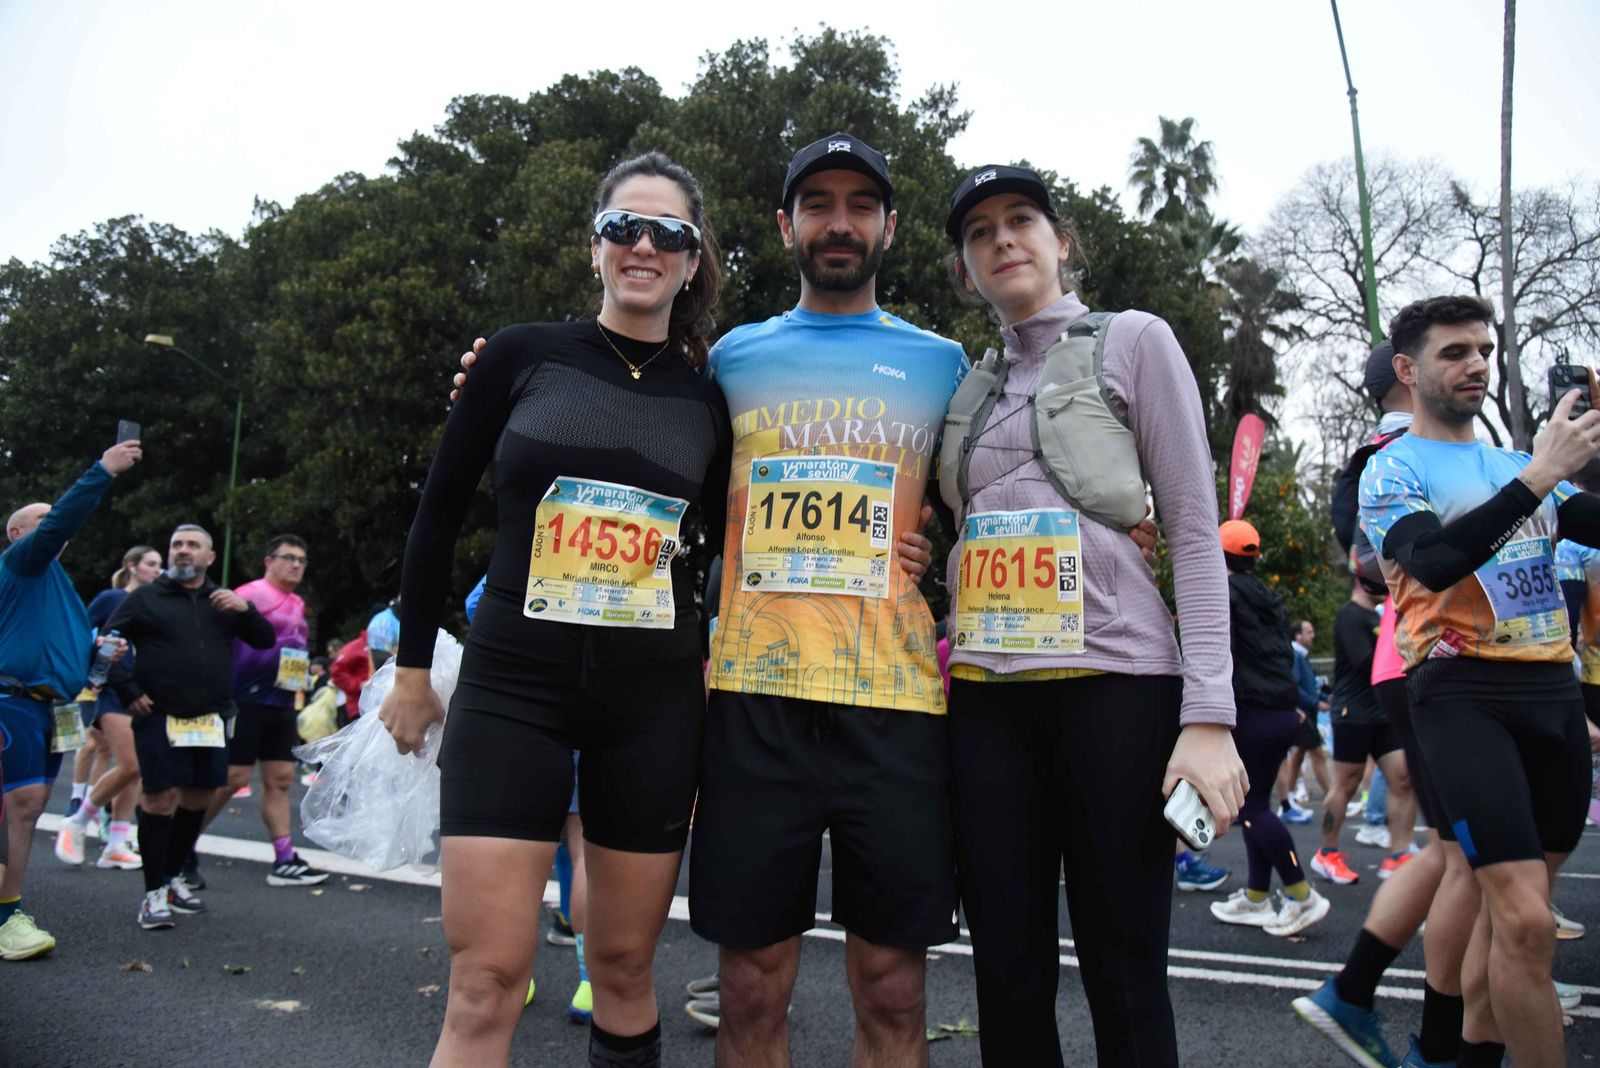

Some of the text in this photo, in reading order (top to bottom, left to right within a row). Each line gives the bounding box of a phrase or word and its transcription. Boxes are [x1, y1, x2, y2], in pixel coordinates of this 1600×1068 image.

[872, 363, 906, 380] HOKA
[757, 397, 886, 431] MEDIO
[798, 460, 848, 470] maratón
[808, 468, 848, 479] sevilla
[760, 491, 870, 533] 17614
[548, 512, 662, 567] 14536
[796, 533, 825, 541] Alfonso
[768, 545, 795, 553] Alfonso
[797, 546, 820, 555] López
[590, 562, 619, 573] MIRCO
[964, 547, 1056, 589] 17615
[592, 576, 620, 586] Ramón
[787, 576, 808, 585] HOKA
[1497, 563, 1554, 600] 3855
[988, 592, 1010, 600] Helena
[577, 607, 600, 616] HOKA
